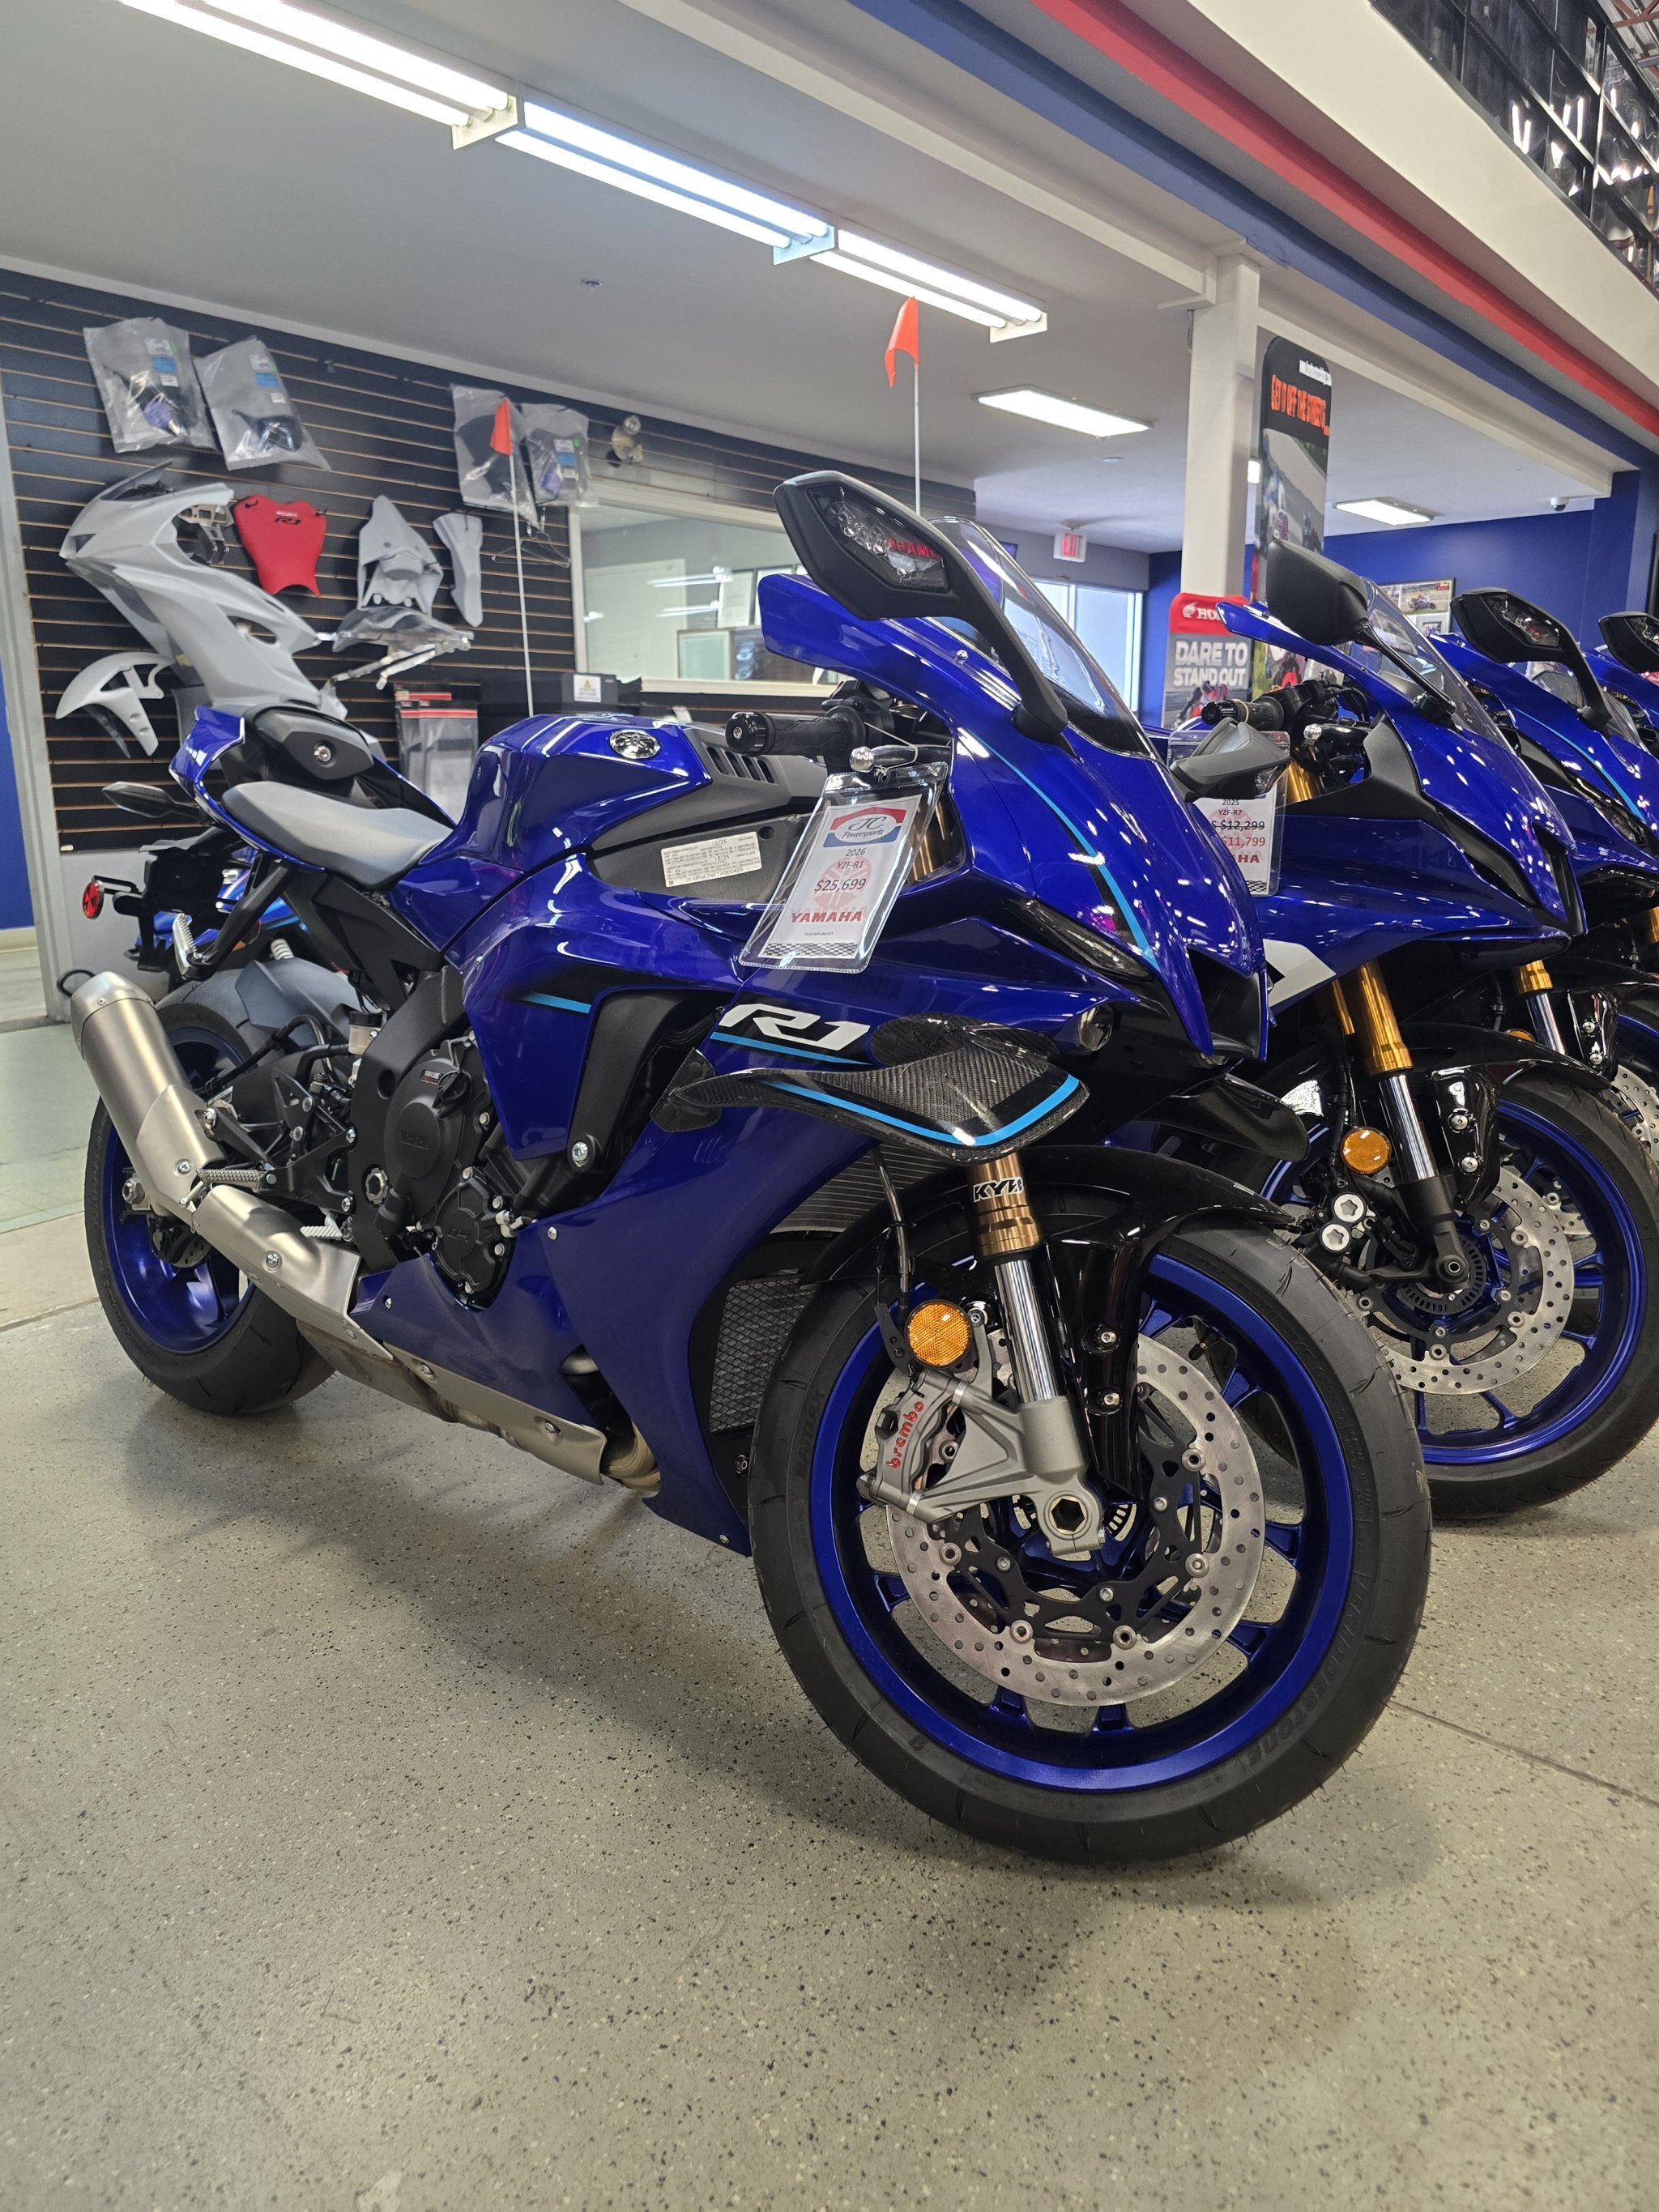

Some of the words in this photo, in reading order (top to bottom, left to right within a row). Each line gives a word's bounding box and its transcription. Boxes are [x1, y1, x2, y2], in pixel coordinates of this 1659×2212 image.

[1175, 641, 1223, 666] DARE
[1225, 641, 1248, 667] TO
[1173, 667, 1218, 687] STAND
[1218, 667, 1247, 687] OUT
[841, 828, 885, 840] Powersports
[845, 848, 866, 857] 2026
[837, 860, 864, 870] YZF-R1
[814, 878, 866, 893] $25,699
[791, 910, 863, 923] YAMAHA
[719, 1003, 871, 1051] R1
[973, 1177, 1025, 1203] KYB
[886, 1401, 924, 1468] brembo
